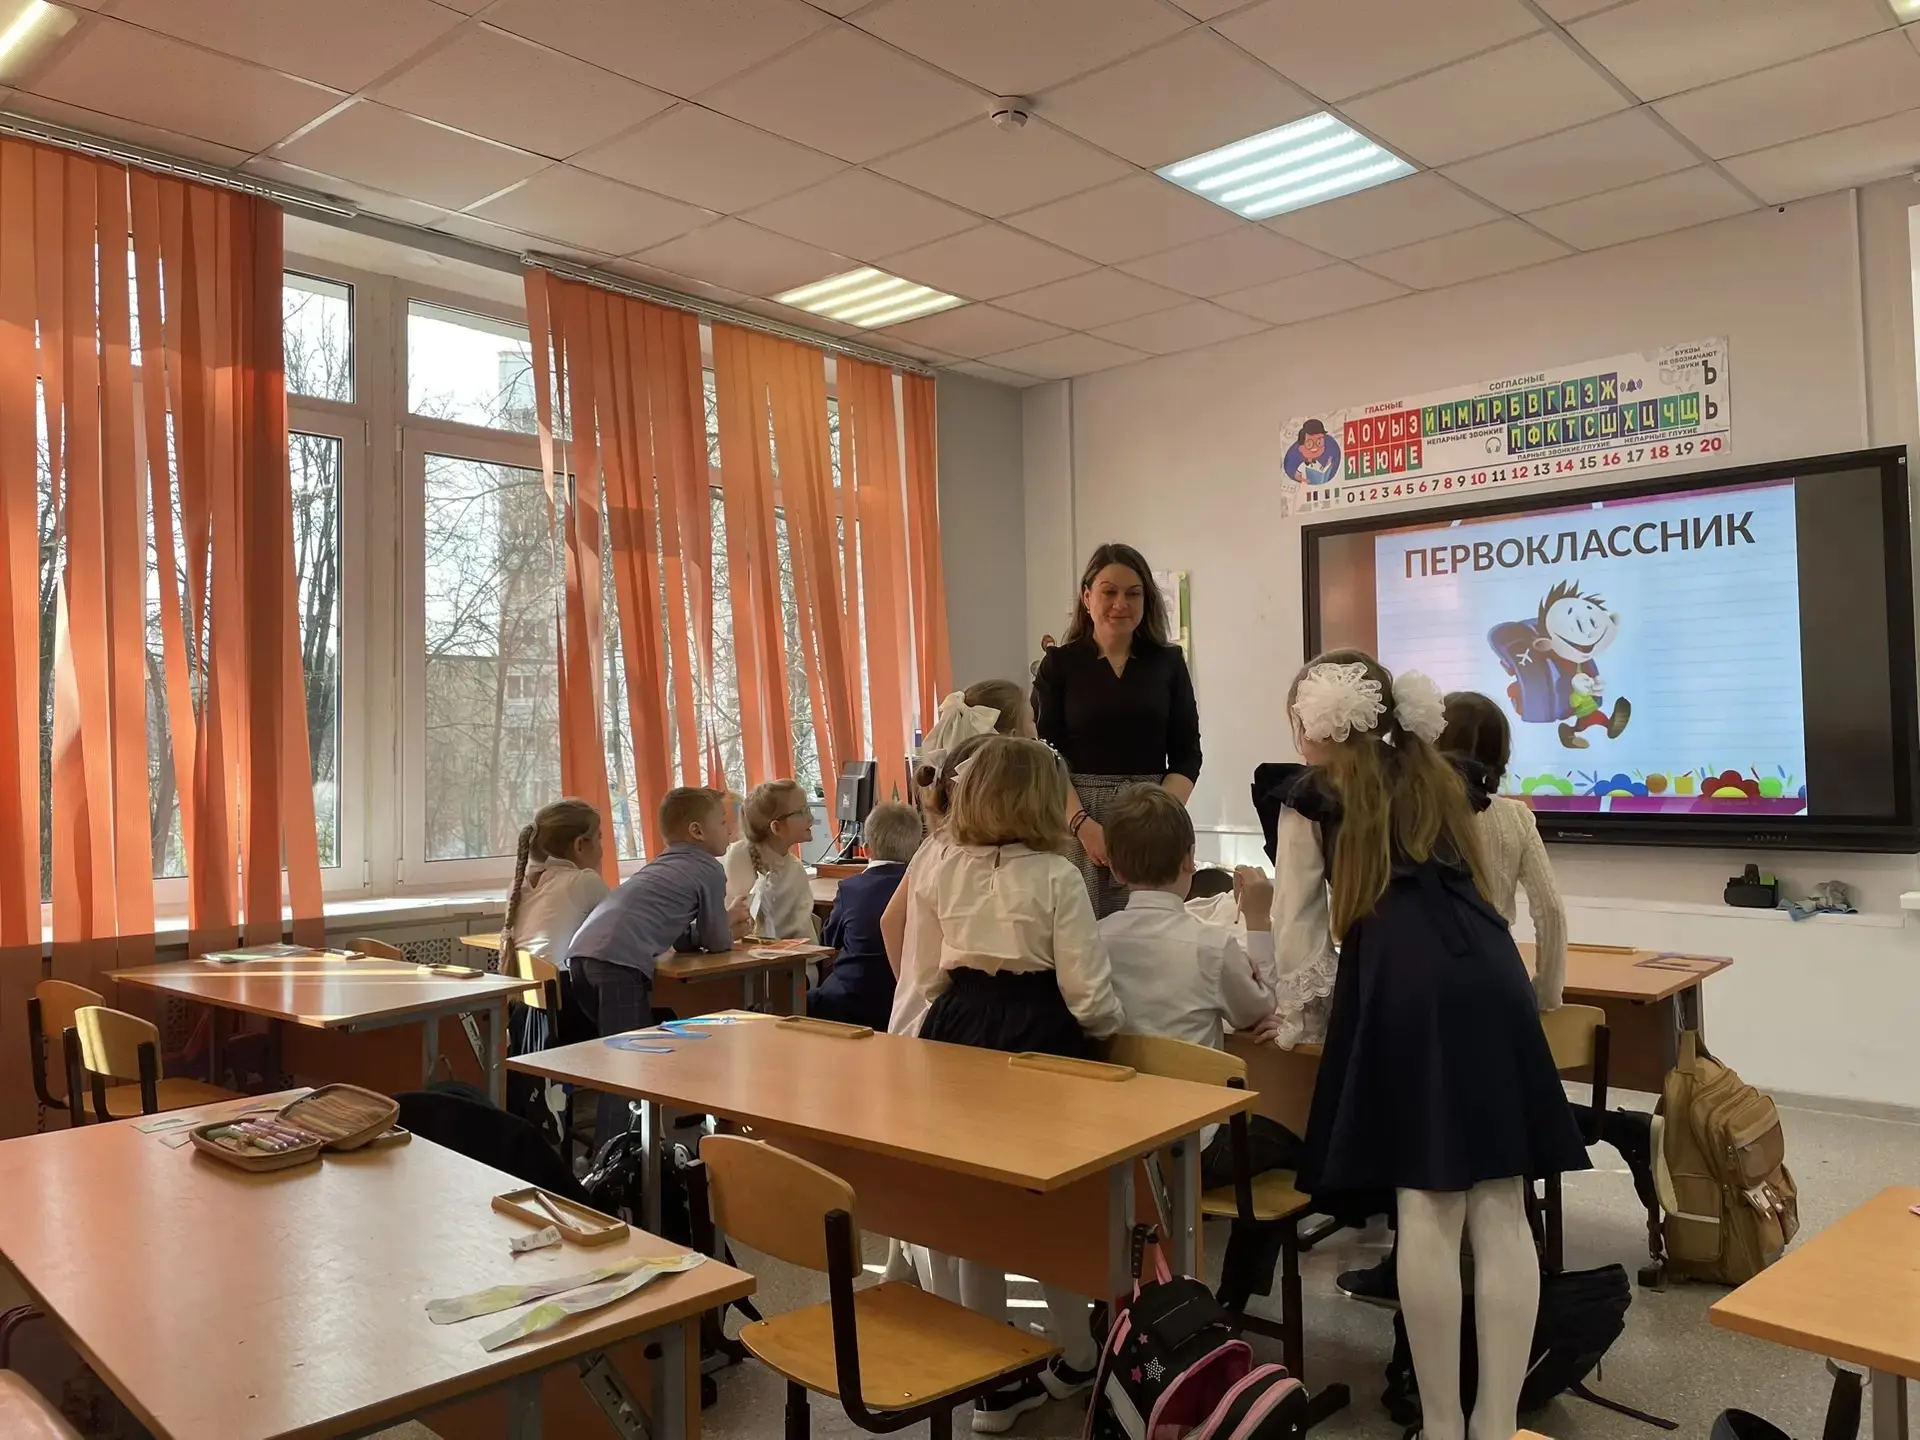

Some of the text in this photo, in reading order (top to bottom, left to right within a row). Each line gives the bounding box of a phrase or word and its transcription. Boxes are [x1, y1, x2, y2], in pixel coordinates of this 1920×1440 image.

[1670, 350, 1717, 364] ОБОЗНАЧАЮТ
[1675, 346, 1700, 356] БУКВЫ
[1489, 374, 1545, 391] СОГЛАСНЫЕ
[1702, 360, 1717, 385] Ъ
[1364, 401, 1404, 414] ГЛАСНЫЕ
[1510, 397, 1520, 416] Б
[1528, 394, 1538, 414] В
[1546, 390, 1556, 410] Г
[1565, 386, 1576, 408] Д
[1584, 384, 1594, 403] З
[1601, 379, 1616, 400] Ж
[1705, 394, 1718, 420] Ь
[1426, 408, 1434, 432] Й
[1442, 408, 1450, 428] Н
[1458, 406, 1468, 426] М
[1476, 403, 1485, 422] Л
[1494, 400, 1502, 420] Р
[1624, 410, 1634, 430] Х
[1642, 405, 1654, 428] Ц
[1663, 402, 1674, 424] Ч
[1680, 398, 1698, 420] Щ
[1347, 416, 1418, 445] А О У Ы Э
[1427, 427, 1504, 446] НЕПАРНЫЕ ЗВОНКИЕ
[1512, 429, 1520, 448] П
[1528, 426, 1540, 445] Ф
[1548, 422, 1556, 442] К
[1566, 420, 1575, 440] Т
[1585, 416, 1594, 436] С
[1602, 412, 1616, 434] Ш
[1624, 428, 1698, 444] НЕПАРНЫЕ ГЛУХИЕ
[1348, 446, 1418, 474] Я Ё Ю И Е
[1518, 441, 1610, 460] ПАРНЫЕ ЗВОНКИЕ/ГЛУХИЕ
[1348, 438, 1722, 502] 0 1 2 3 4 5 6 7 8 9 10 11 12 13 14 15 16 17 18 19 20
[1404, 511, 1755, 579] ПЕРВОКЛАССНИК
